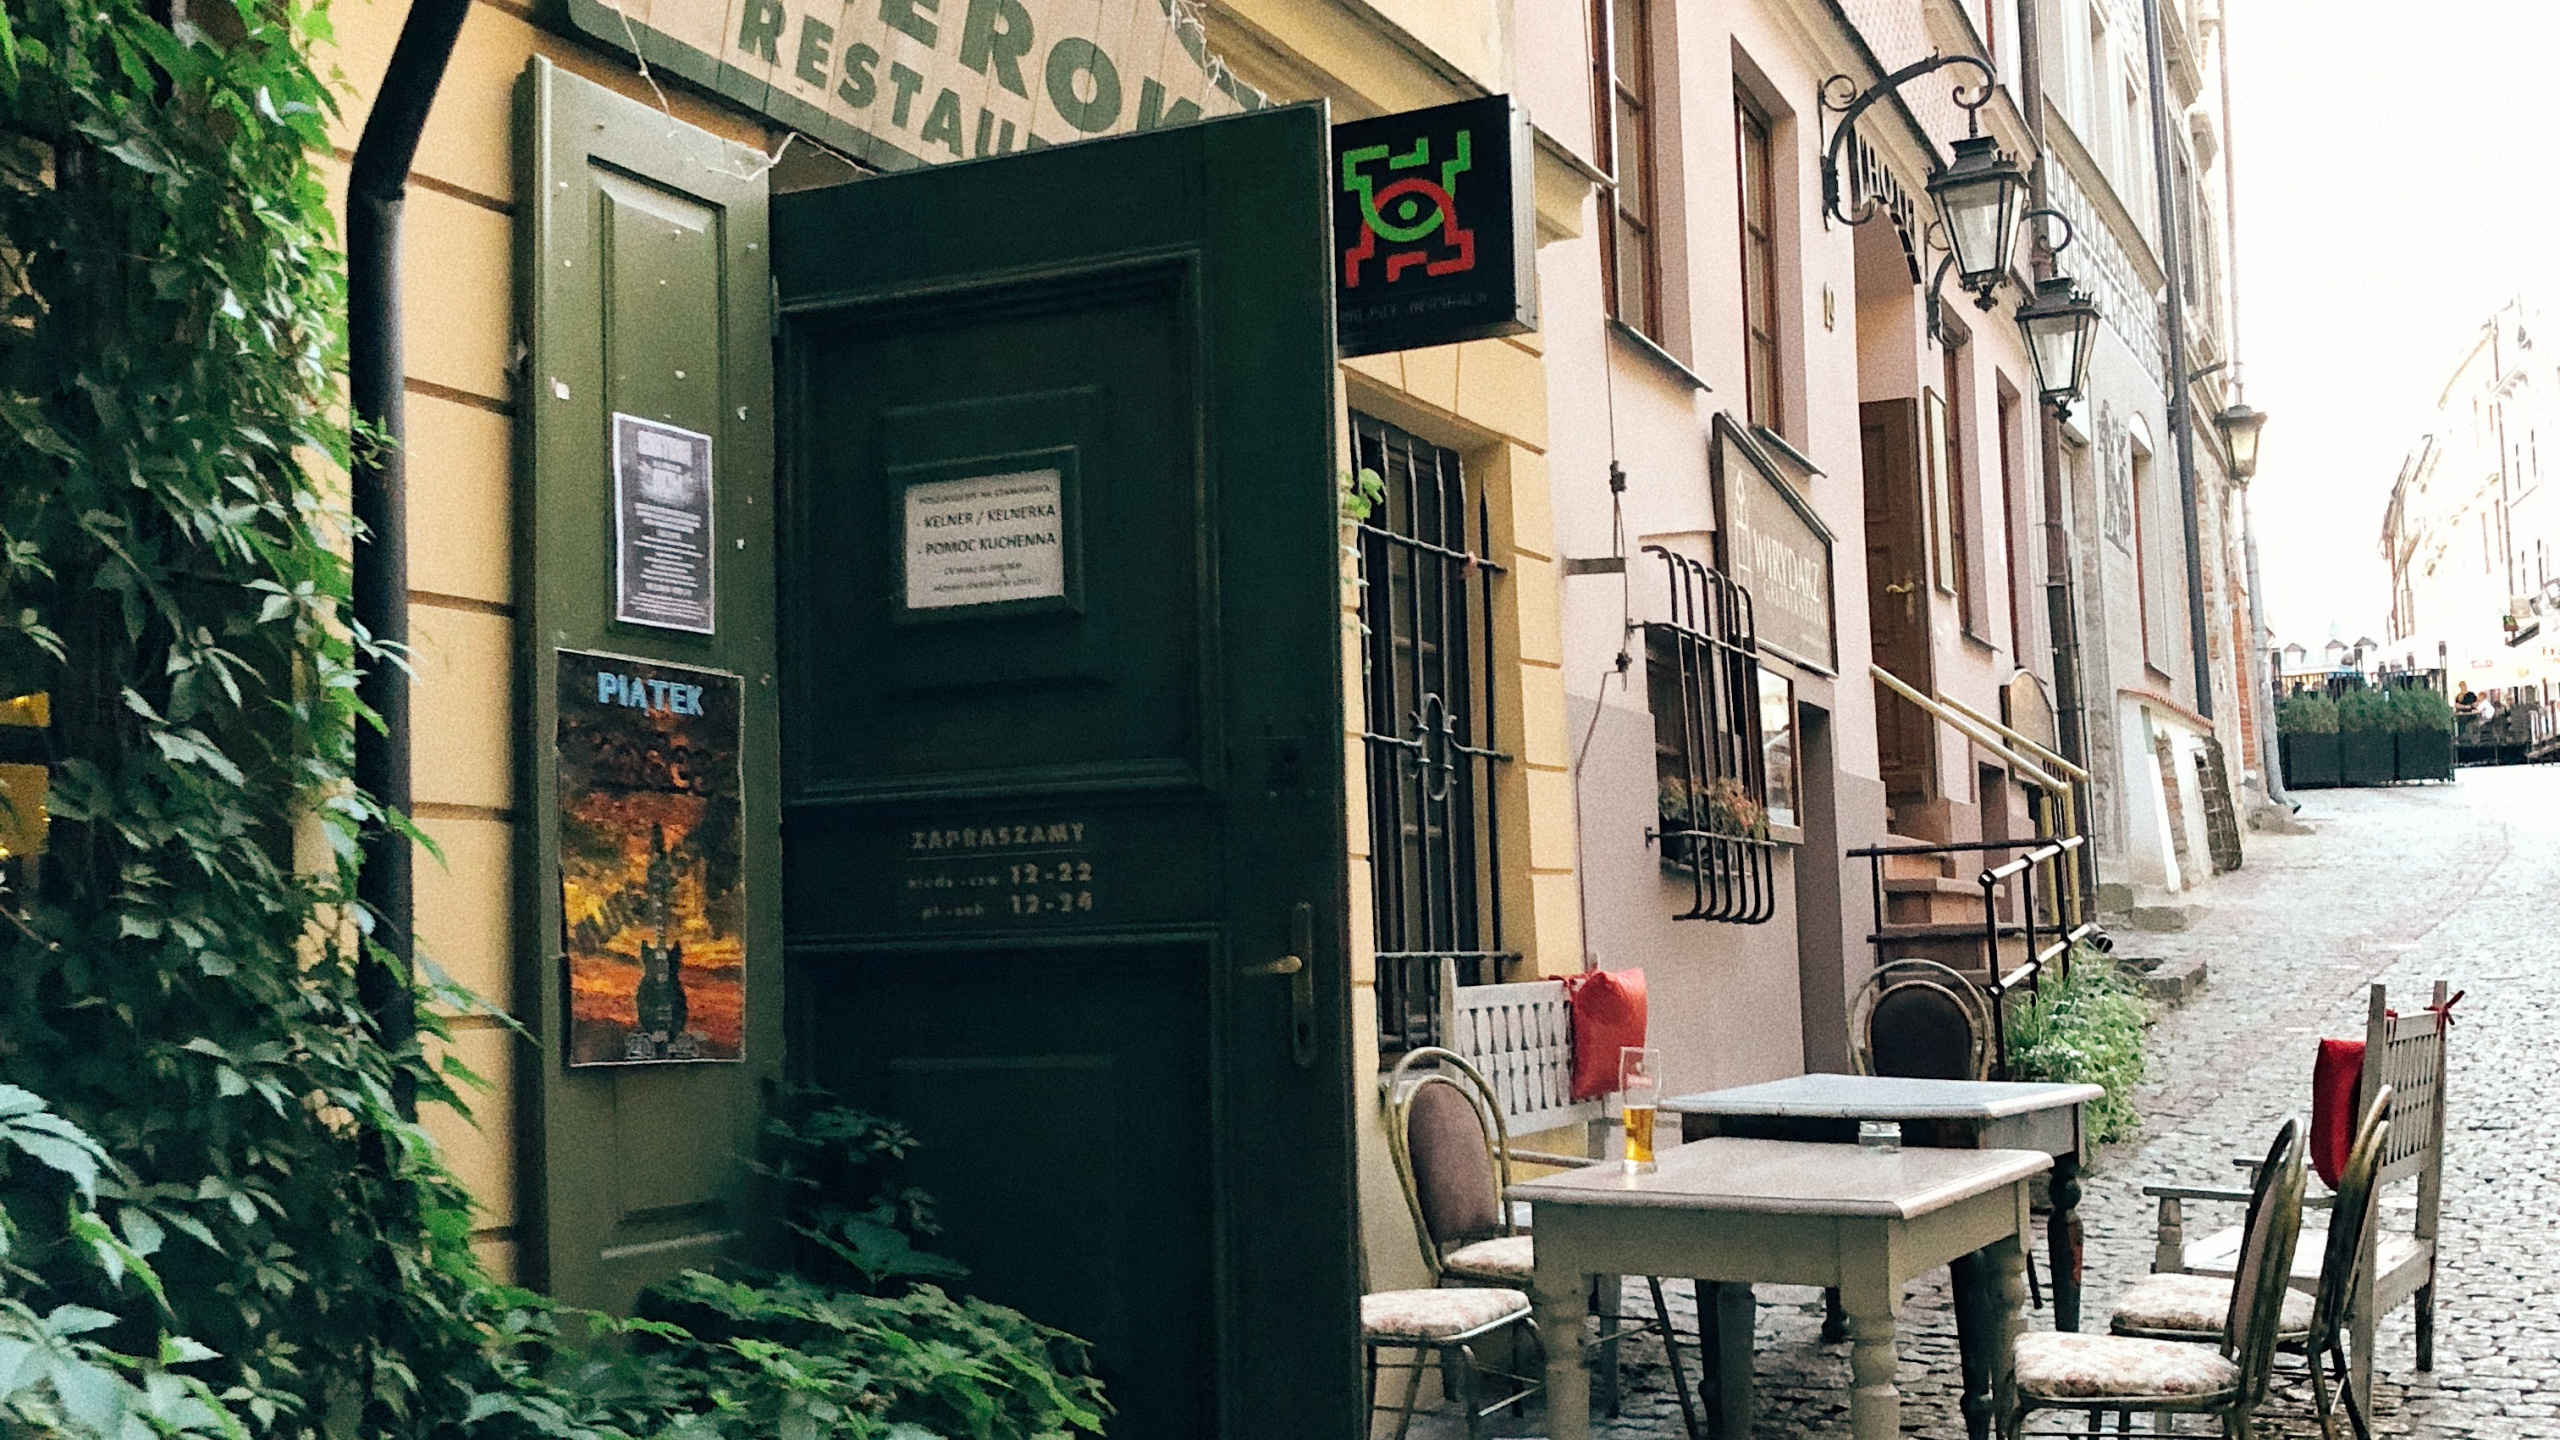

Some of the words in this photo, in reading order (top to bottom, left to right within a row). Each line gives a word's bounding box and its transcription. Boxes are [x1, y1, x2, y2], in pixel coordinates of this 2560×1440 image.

[738, 0, 1051, 158] RESTAU
[924, 512, 973, 529] KELNER
[987, 504, 1056, 523] KELNERKA
[926, 538, 977, 556] POMOC
[980, 532, 1056, 551] KUCHENNA
[1753, 528, 1820, 603] WIRYDARZ
[911, 822, 1085, 849] ZAPRASZAMY
